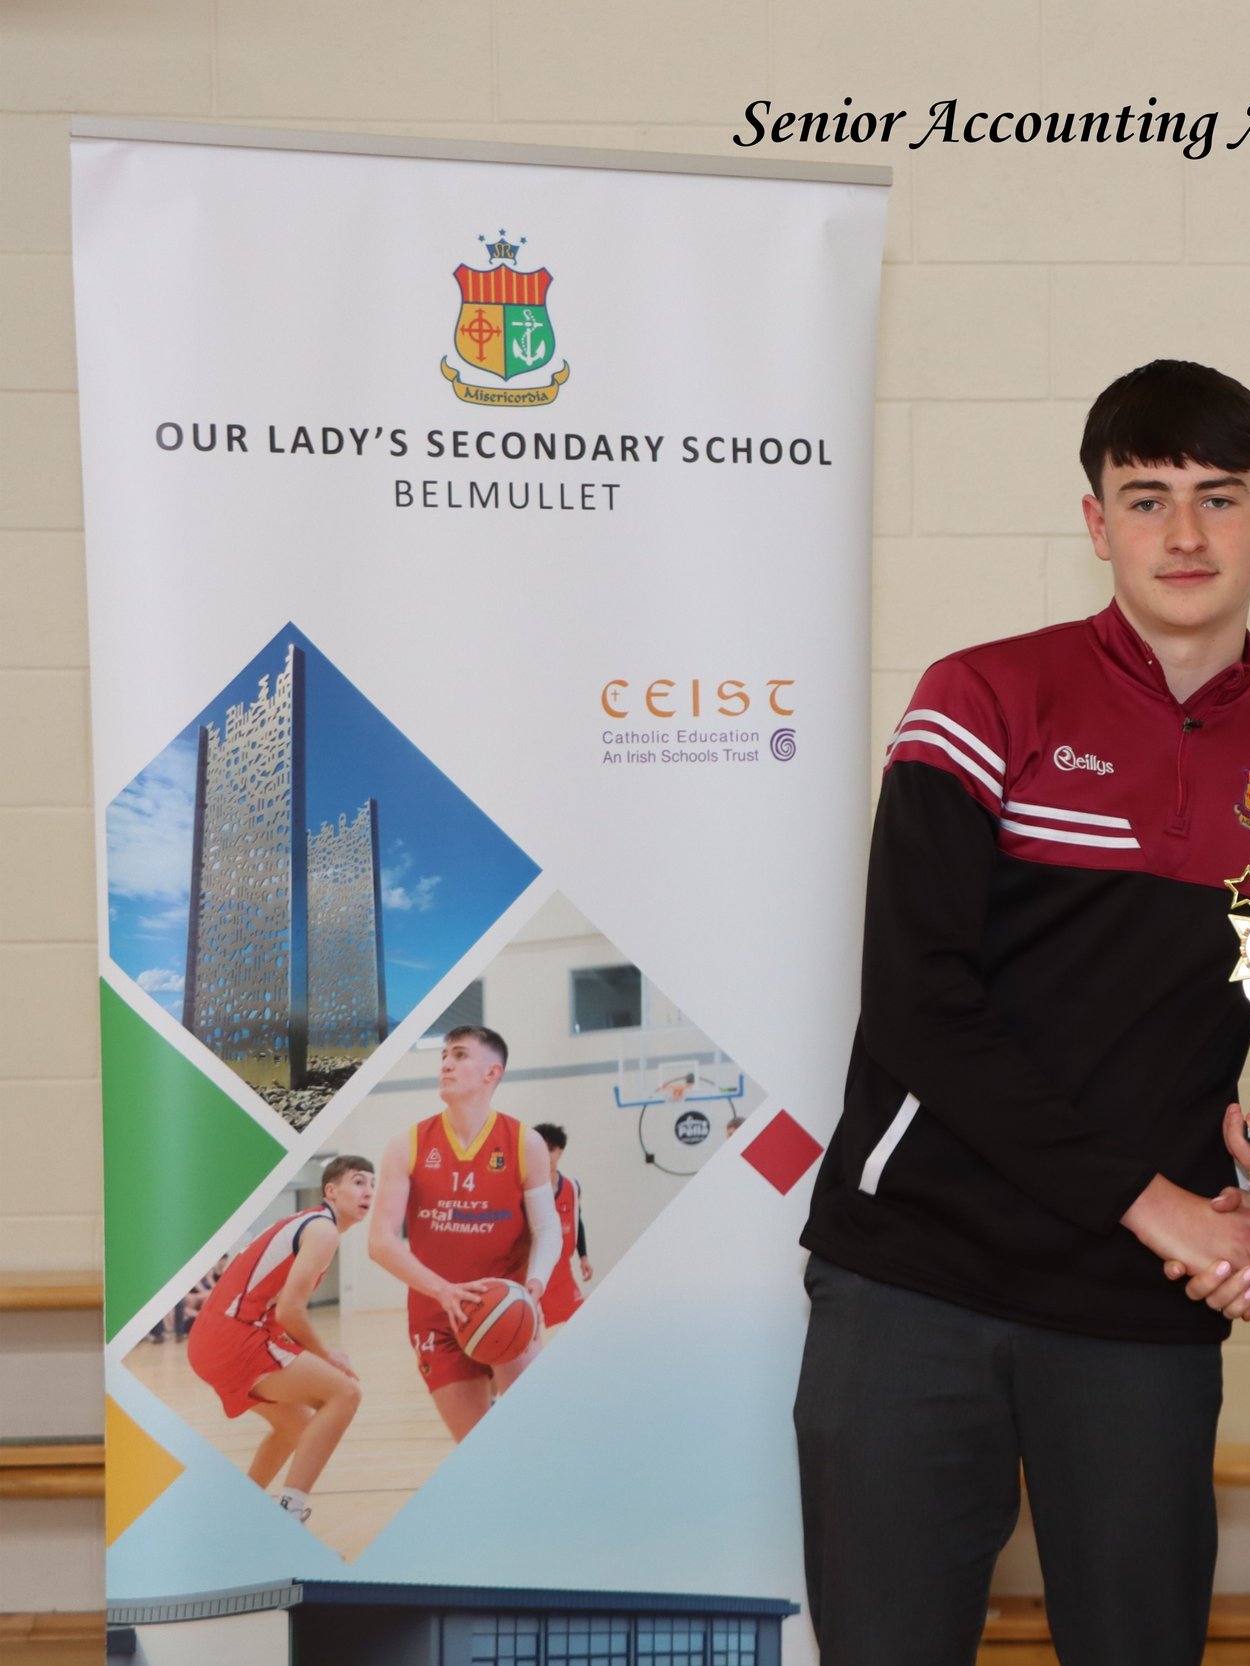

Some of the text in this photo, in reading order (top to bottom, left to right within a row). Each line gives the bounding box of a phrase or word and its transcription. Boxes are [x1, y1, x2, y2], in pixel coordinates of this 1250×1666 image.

[464, 387, 549, 403] Misericordia
[155, 422, 249, 453] OUR
[427, 429, 665, 463] SECONDARY
[682, 435, 833, 466] SCHOOL
[395, 479, 621, 511] BELMULLET
[601, 679, 796, 718] CEIST
[602, 729, 760, 744] Catholic Education
[602, 748, 759, 764] An Irish Schools Trust
[1053, 745, 1115, 776] Reillys
[452, 1171, 476, 1191] 14
[431, 1221, 495, 1233] PHARMACY
